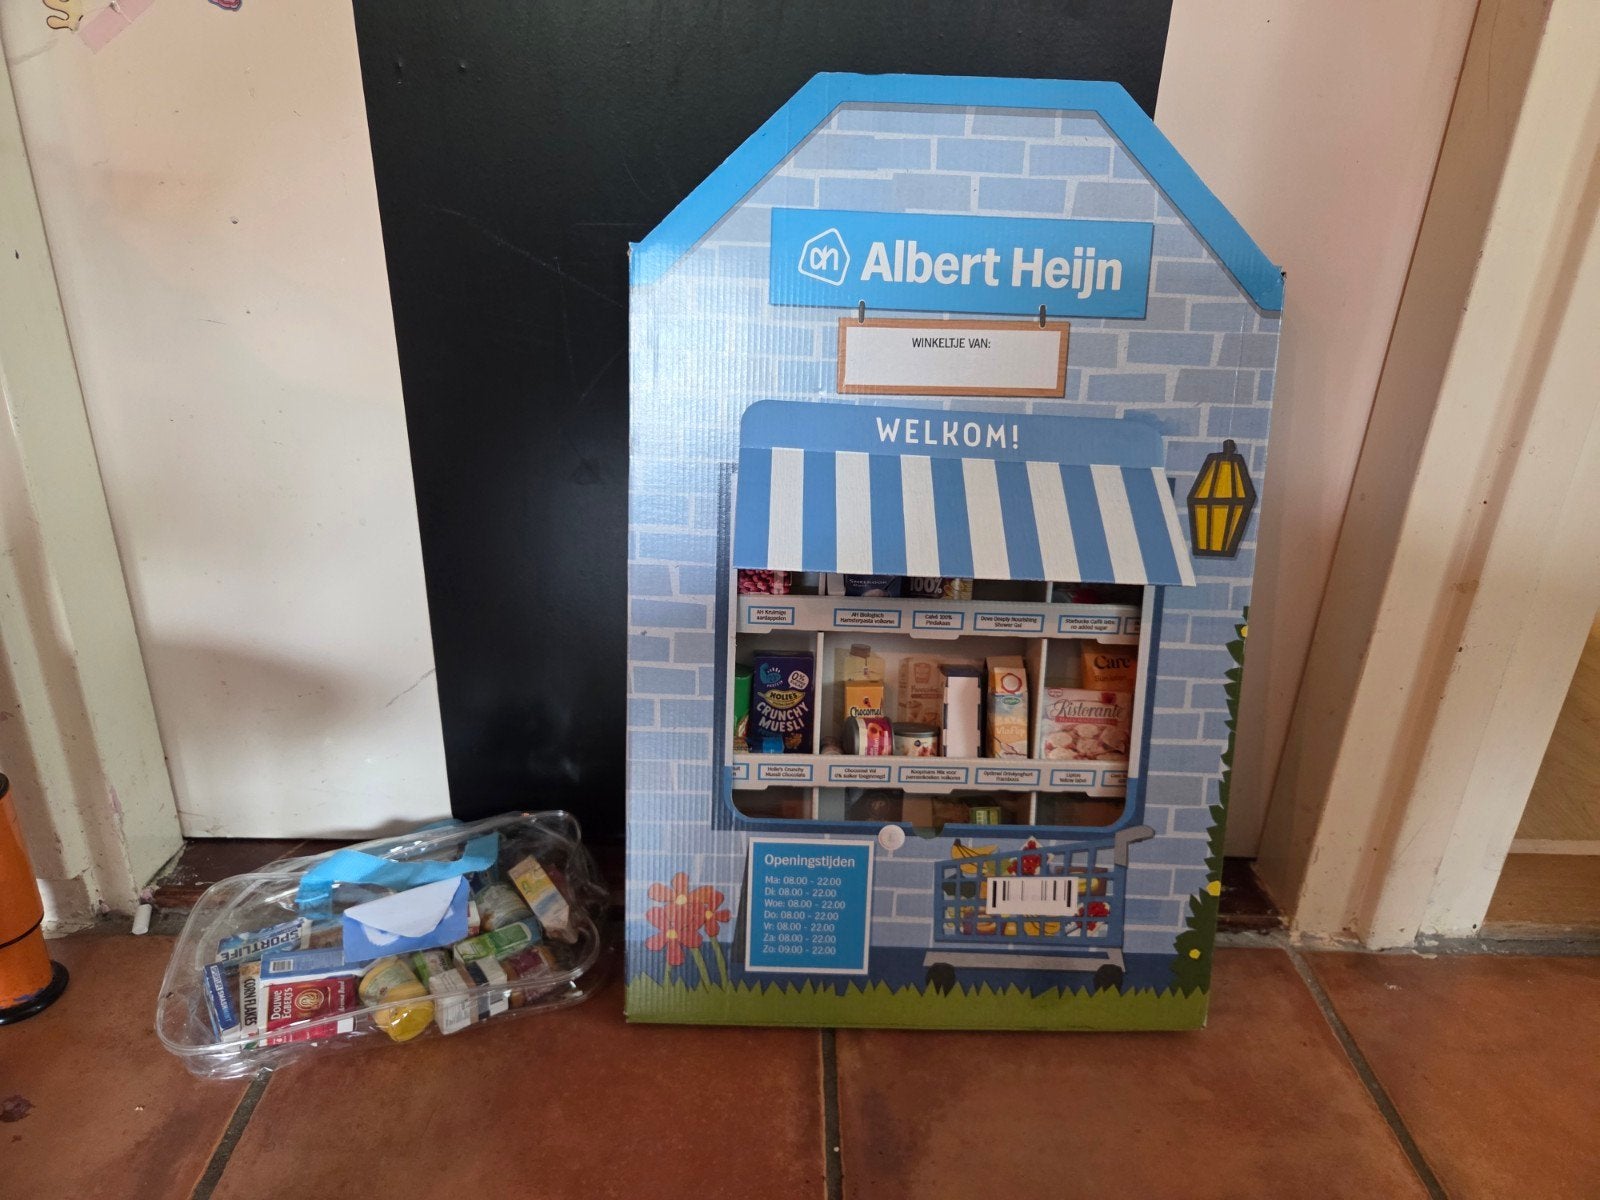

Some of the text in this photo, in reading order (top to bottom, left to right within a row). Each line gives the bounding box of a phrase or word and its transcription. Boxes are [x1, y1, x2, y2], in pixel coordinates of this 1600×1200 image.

[860, 239, 1000, 287] Albert
[1011, 246, 1122, 299] Heijn
[912, 337, 991, 349] WINKELTJE VAN:
[876, 416, 1019, 448] WELKOM!
[910, 577, 943, 594] 100%
[1094, 655, 1130, 669] Care
[756, 701, 809, 721] CRUNCHY
[849, 706, 882, 717] Chocomel
[1050, 698, 1123, 719] Ristorante
[758, 716, 805, 733] MUESLI
[764, 853, 855, 869] Openingstijden
[220, 929, 300, 962] SPORTLIFE
[243, 978, 257, 1026] CORN FLAKES
[281, 987, 293, 1019] EGBERTS
